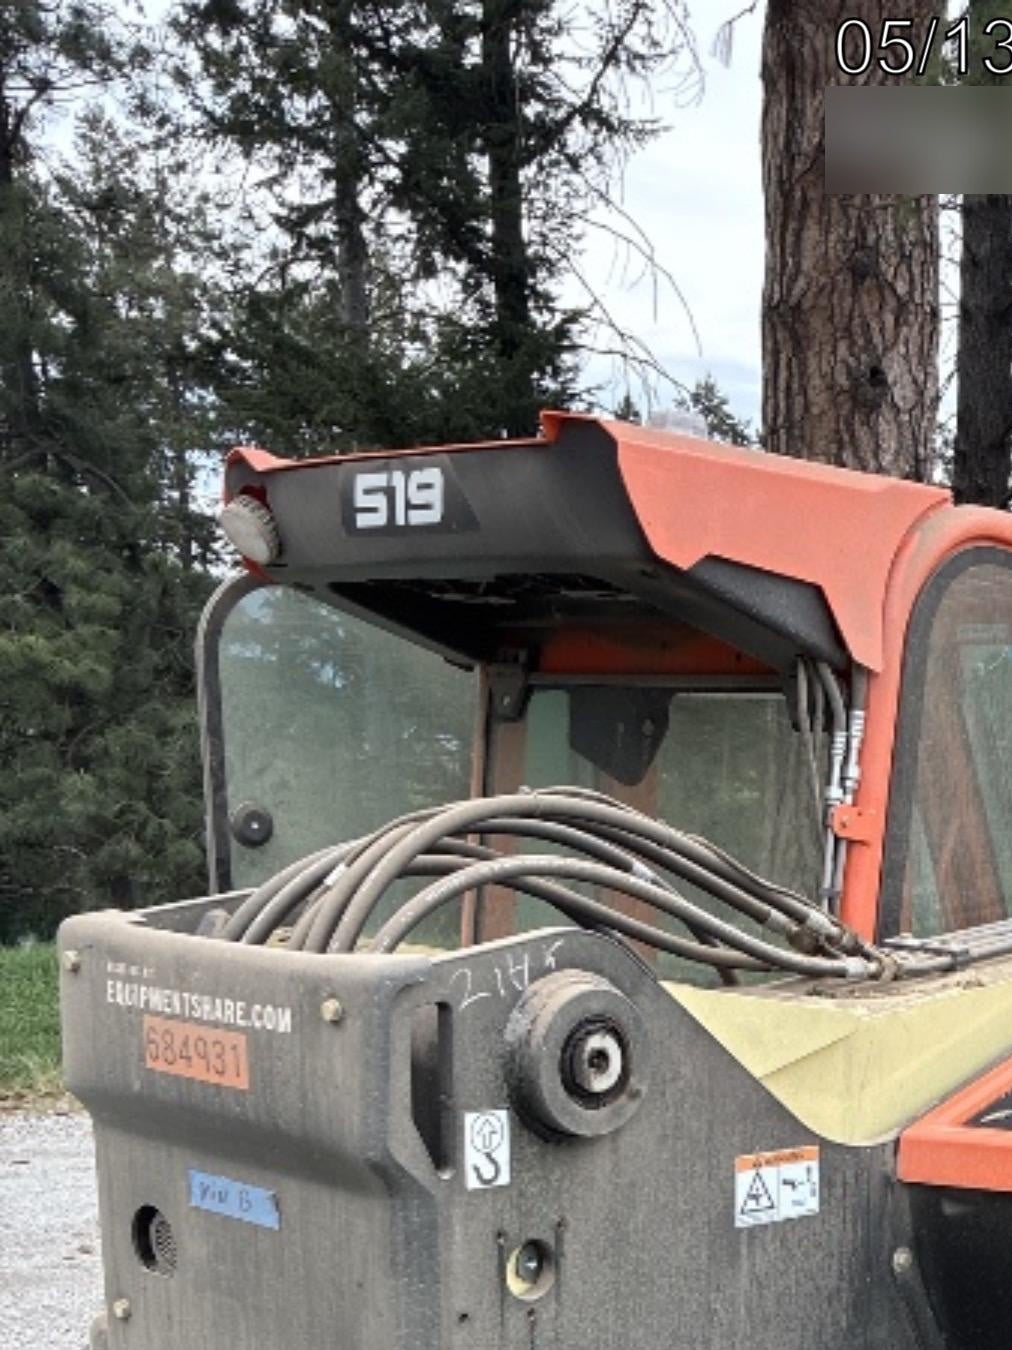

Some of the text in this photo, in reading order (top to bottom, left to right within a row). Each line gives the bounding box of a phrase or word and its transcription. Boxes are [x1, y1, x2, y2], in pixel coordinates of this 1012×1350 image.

[354, 467, 445, 529] 519
[106, 979, 293, 1033] EQUIPMENTSHARE.COM
[146, 1026, 242, 1078] 684931
